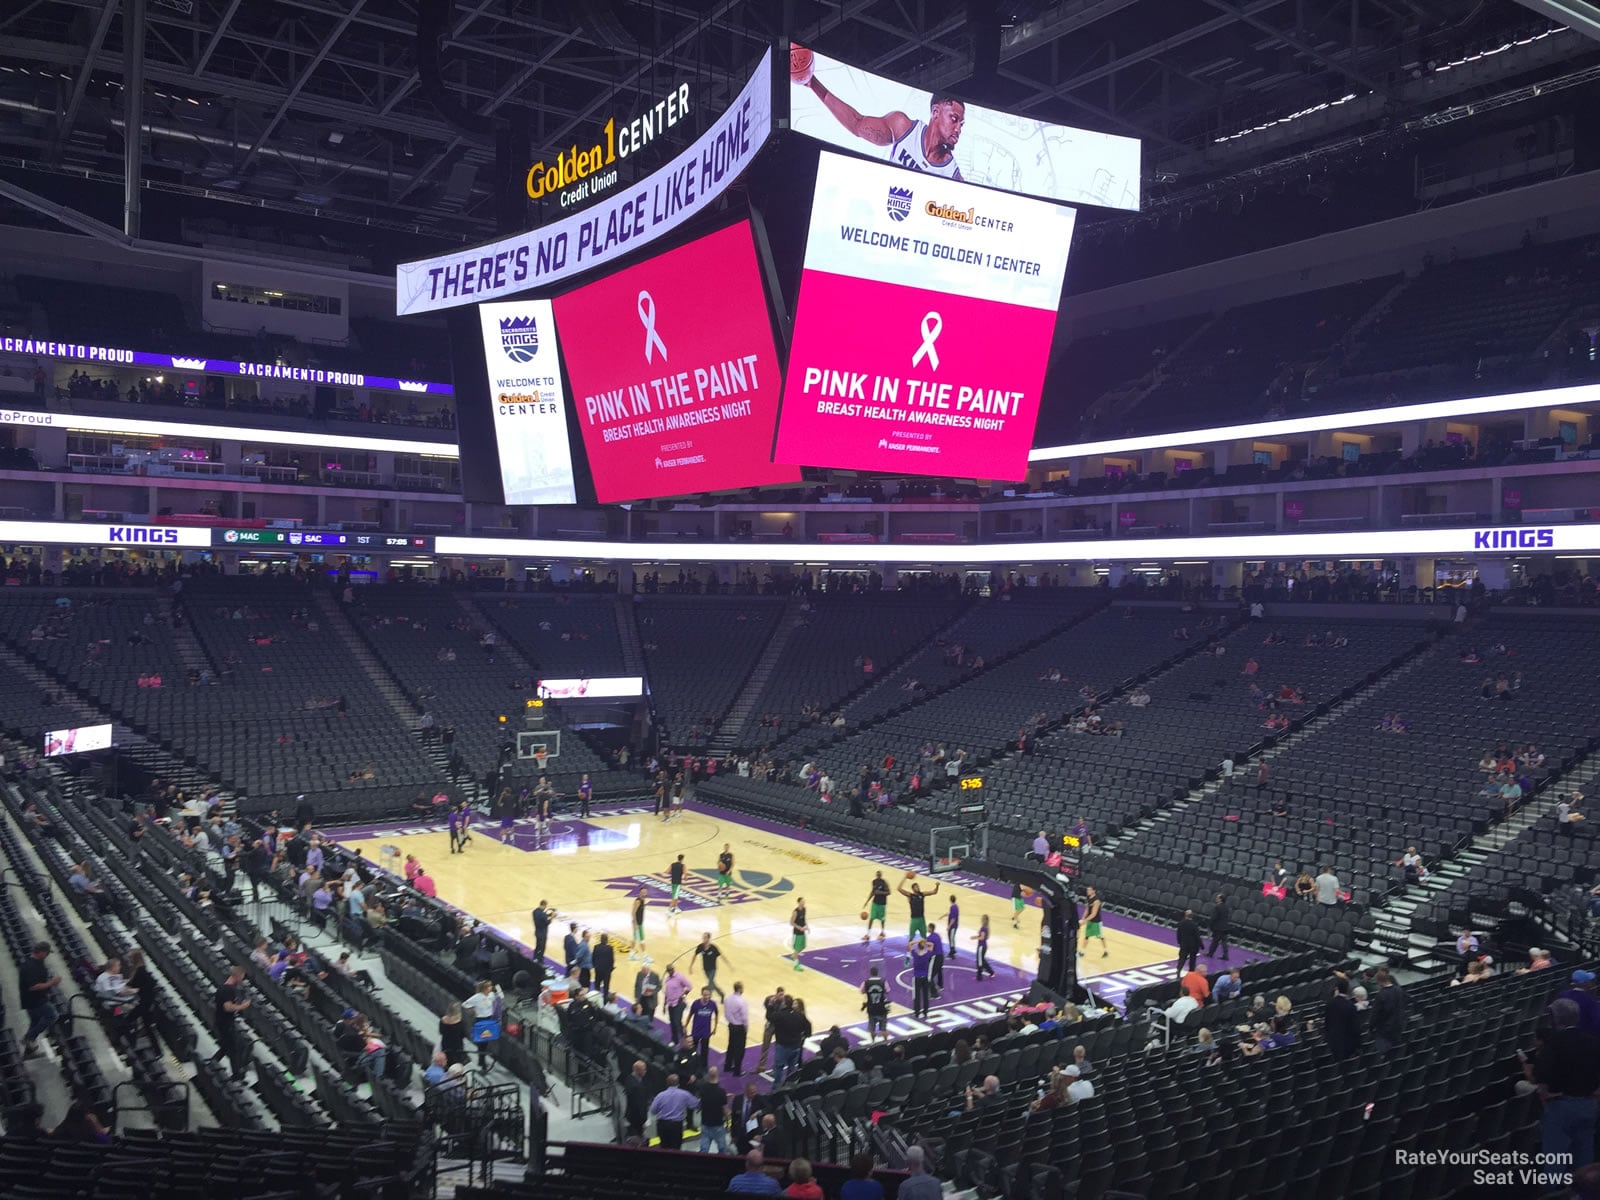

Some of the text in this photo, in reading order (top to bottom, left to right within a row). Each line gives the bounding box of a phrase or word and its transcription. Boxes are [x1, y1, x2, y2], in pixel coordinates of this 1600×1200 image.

[618, 82, 690, 158] CENTER
[428, 97, 752, 300] THERE'S NO PLACE LIKE HOME
[560, 170, 617, 208] Credit Union
[887, 198, 912, 211] KINGS
[974, 215, 1014, 232] CENTER
[840, 225, 1041, 277] WELCOME TO GOLDEN 1 CENTER
[502, 334, 539, 346] KINGS
[89, 346, 134, 363] PROUD
[239, 362, 364, 386] SACRAMENTO PROUD
[497, 377, 555, 388] WELCOME TO
[585, 355, 760, 425] PINK IN THE PAINT
[803, 367, 1024, 416] PINK IN THE PAINT
[499, 403, 557, 416] CENTER
[817, 400, 1005, 431] BREAST HEALTH AWARENESS NIGHT
[602, 399, 752, 443] BREAST HEALTH AWARENESS NIGHT
[109, 527, 178, 543] KINGS
[240, 532, 259, 541] MAC
[277, 533, 284, 541] 0
[304, 534, 322, 543] SAC
[1474, 529, 1554, 549] KINGS
